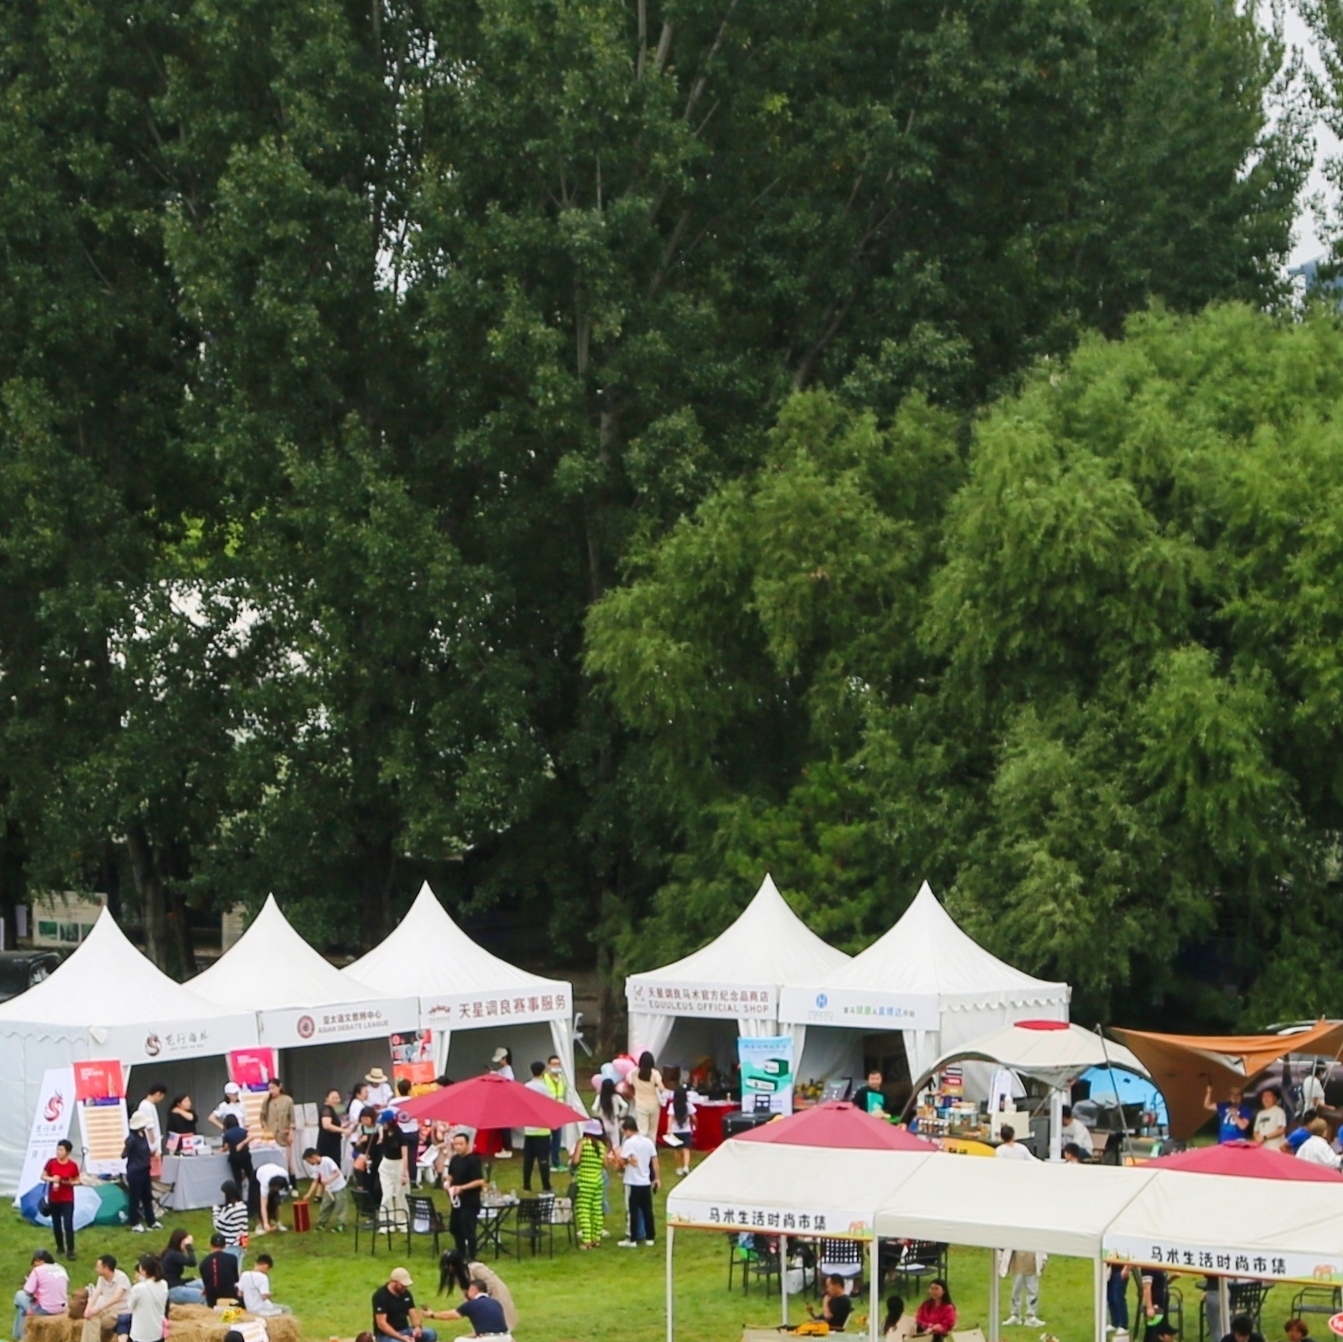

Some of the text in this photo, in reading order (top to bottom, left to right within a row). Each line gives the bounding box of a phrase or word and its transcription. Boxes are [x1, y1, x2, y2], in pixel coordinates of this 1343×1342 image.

[459, 994, 566, 1019] 天星调良赛事服务
[649, 1001, 769, 1014] EQUULEUS OFFICIAL SHOP
[318, 1019, 389, 1034] ASIAN DEBATE LEAGUE
[709, 1207, 826, 1231] 马术生活时尚市集
[1151, 1246, 1286, 1274] 马术生活时尚市集
